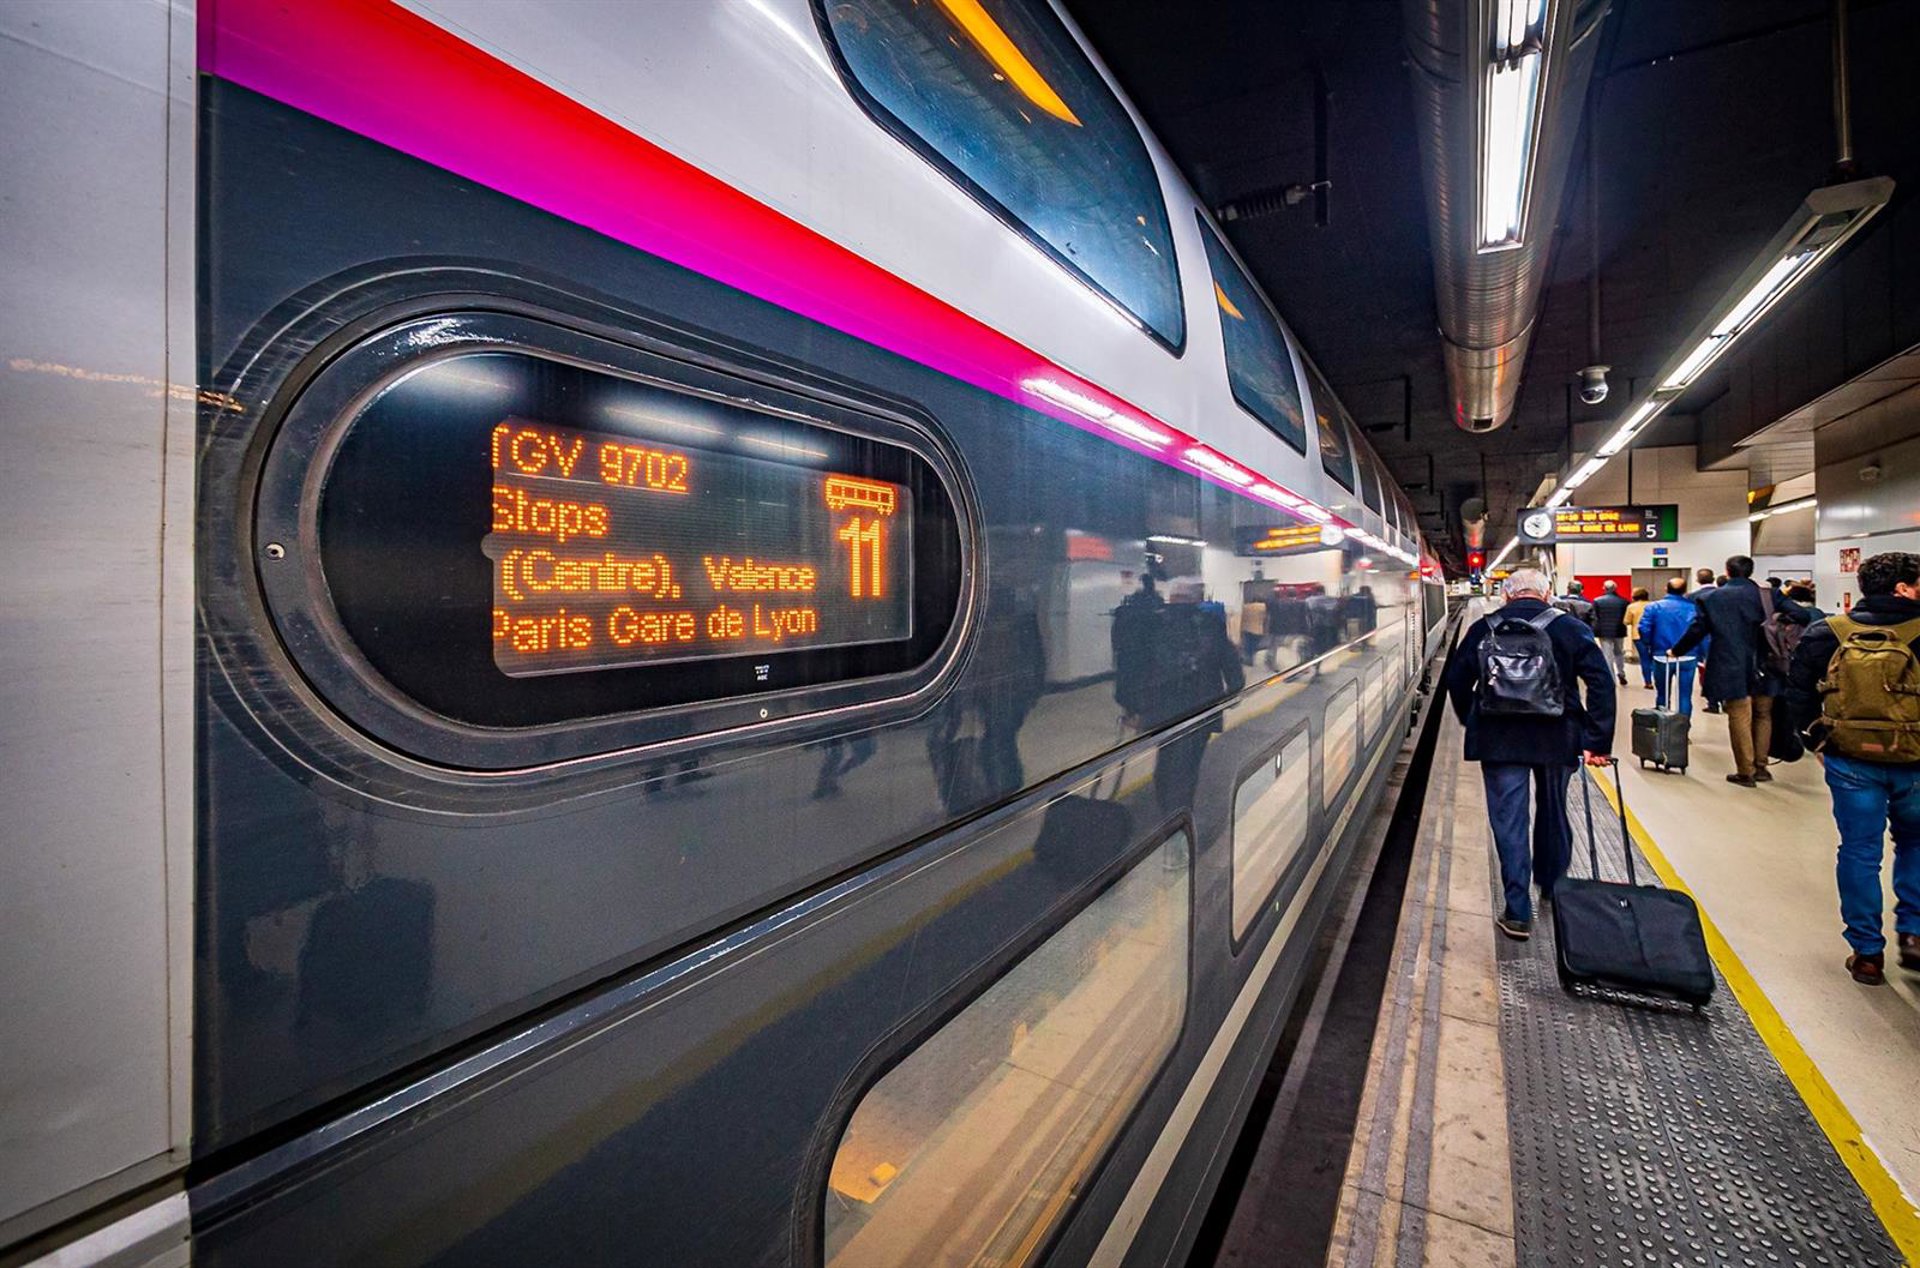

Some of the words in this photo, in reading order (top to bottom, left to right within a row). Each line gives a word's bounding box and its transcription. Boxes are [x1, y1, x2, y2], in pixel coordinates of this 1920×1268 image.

[600, 444, 689, 491] 9702
[492, 488, 608, 543] Stops
[1646, 523, 1657, 539] 5
[704, 557, 815, 592] Valence
[839, 517, 883, 597] 11
[609, 606, 695, 644] Gare
[707, 604, 744, 638] de
[753, 604, 816, 642] Lyon
